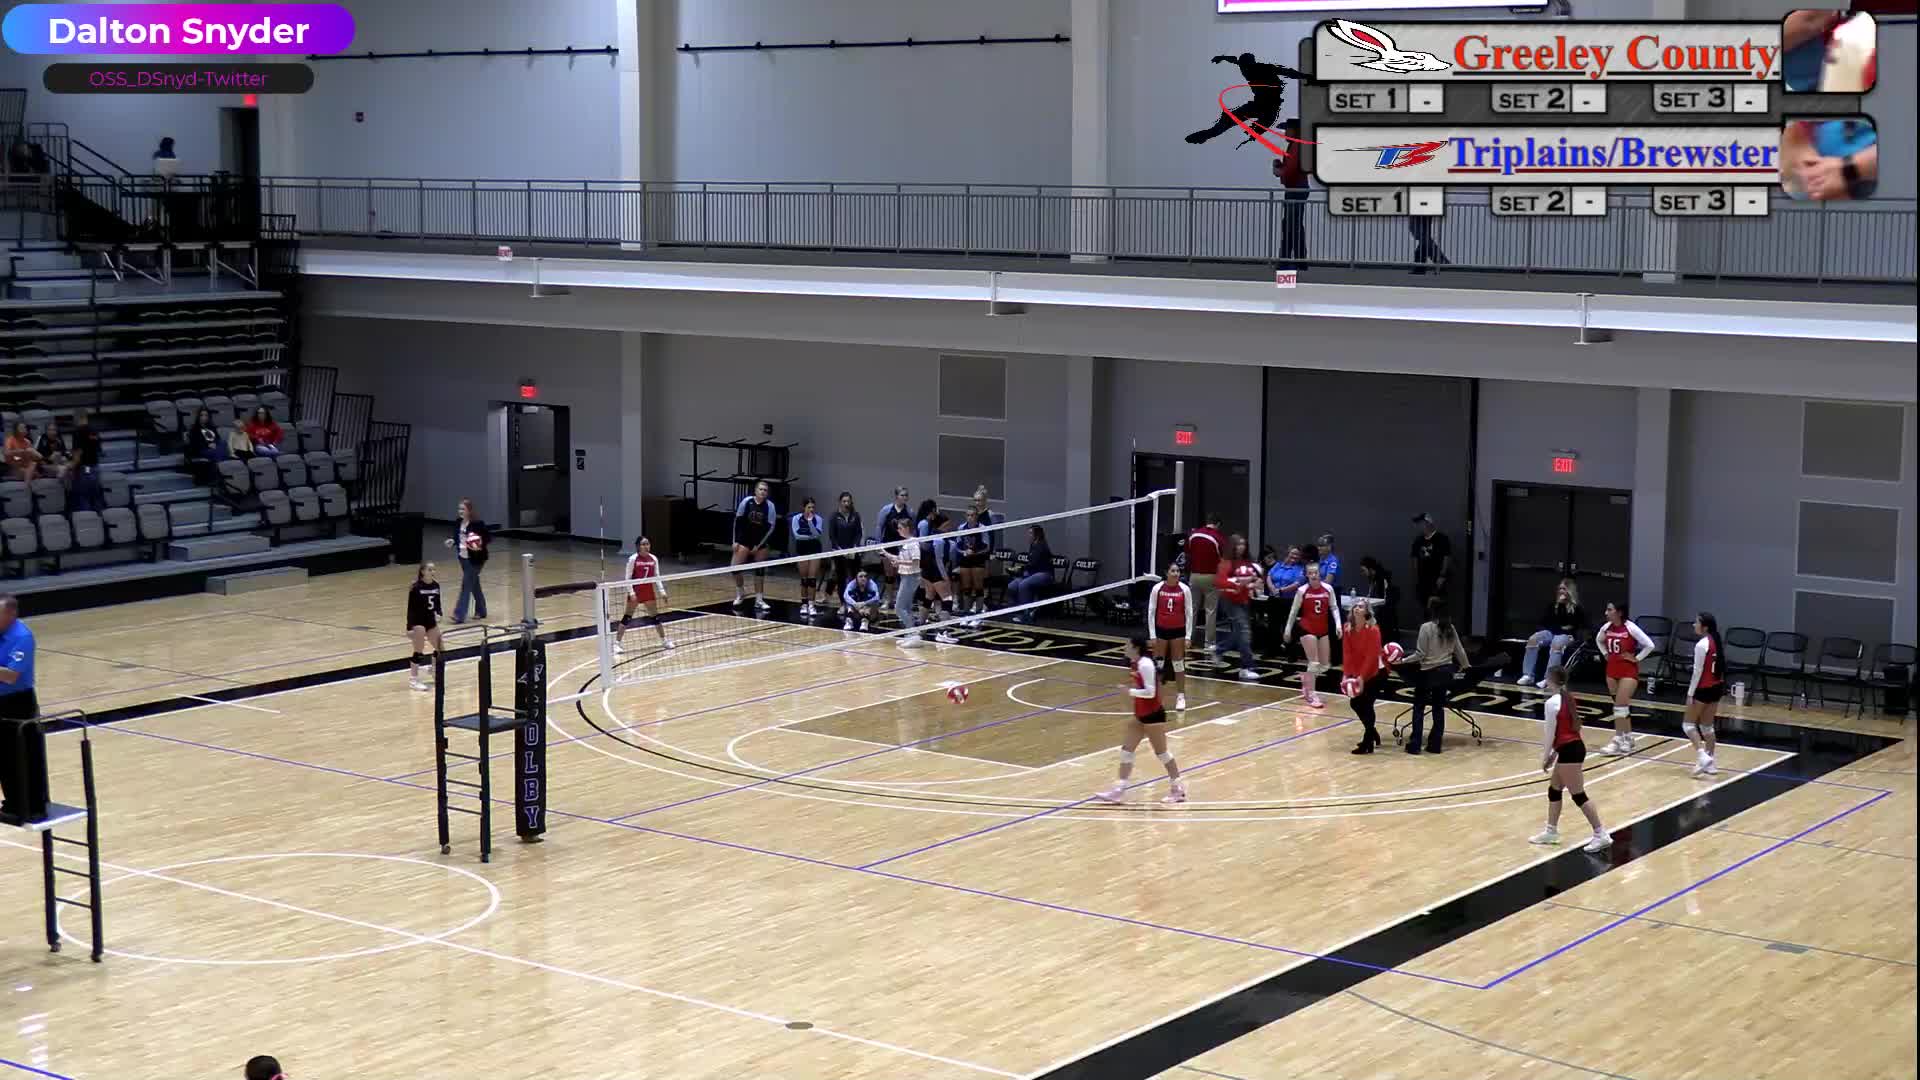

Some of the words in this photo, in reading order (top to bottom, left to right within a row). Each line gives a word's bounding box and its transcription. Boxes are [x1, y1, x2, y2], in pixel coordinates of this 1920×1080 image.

[1277, 274, 1297, 284] EXIT
[1555, 458, 1574, 472] EXIT
[995, 551, 1012, 559] OLBY
[427, 595, 435, 610] 5
[1167, 598, 1174, 612] 4
[1607, 638, 1620, 654] 16
